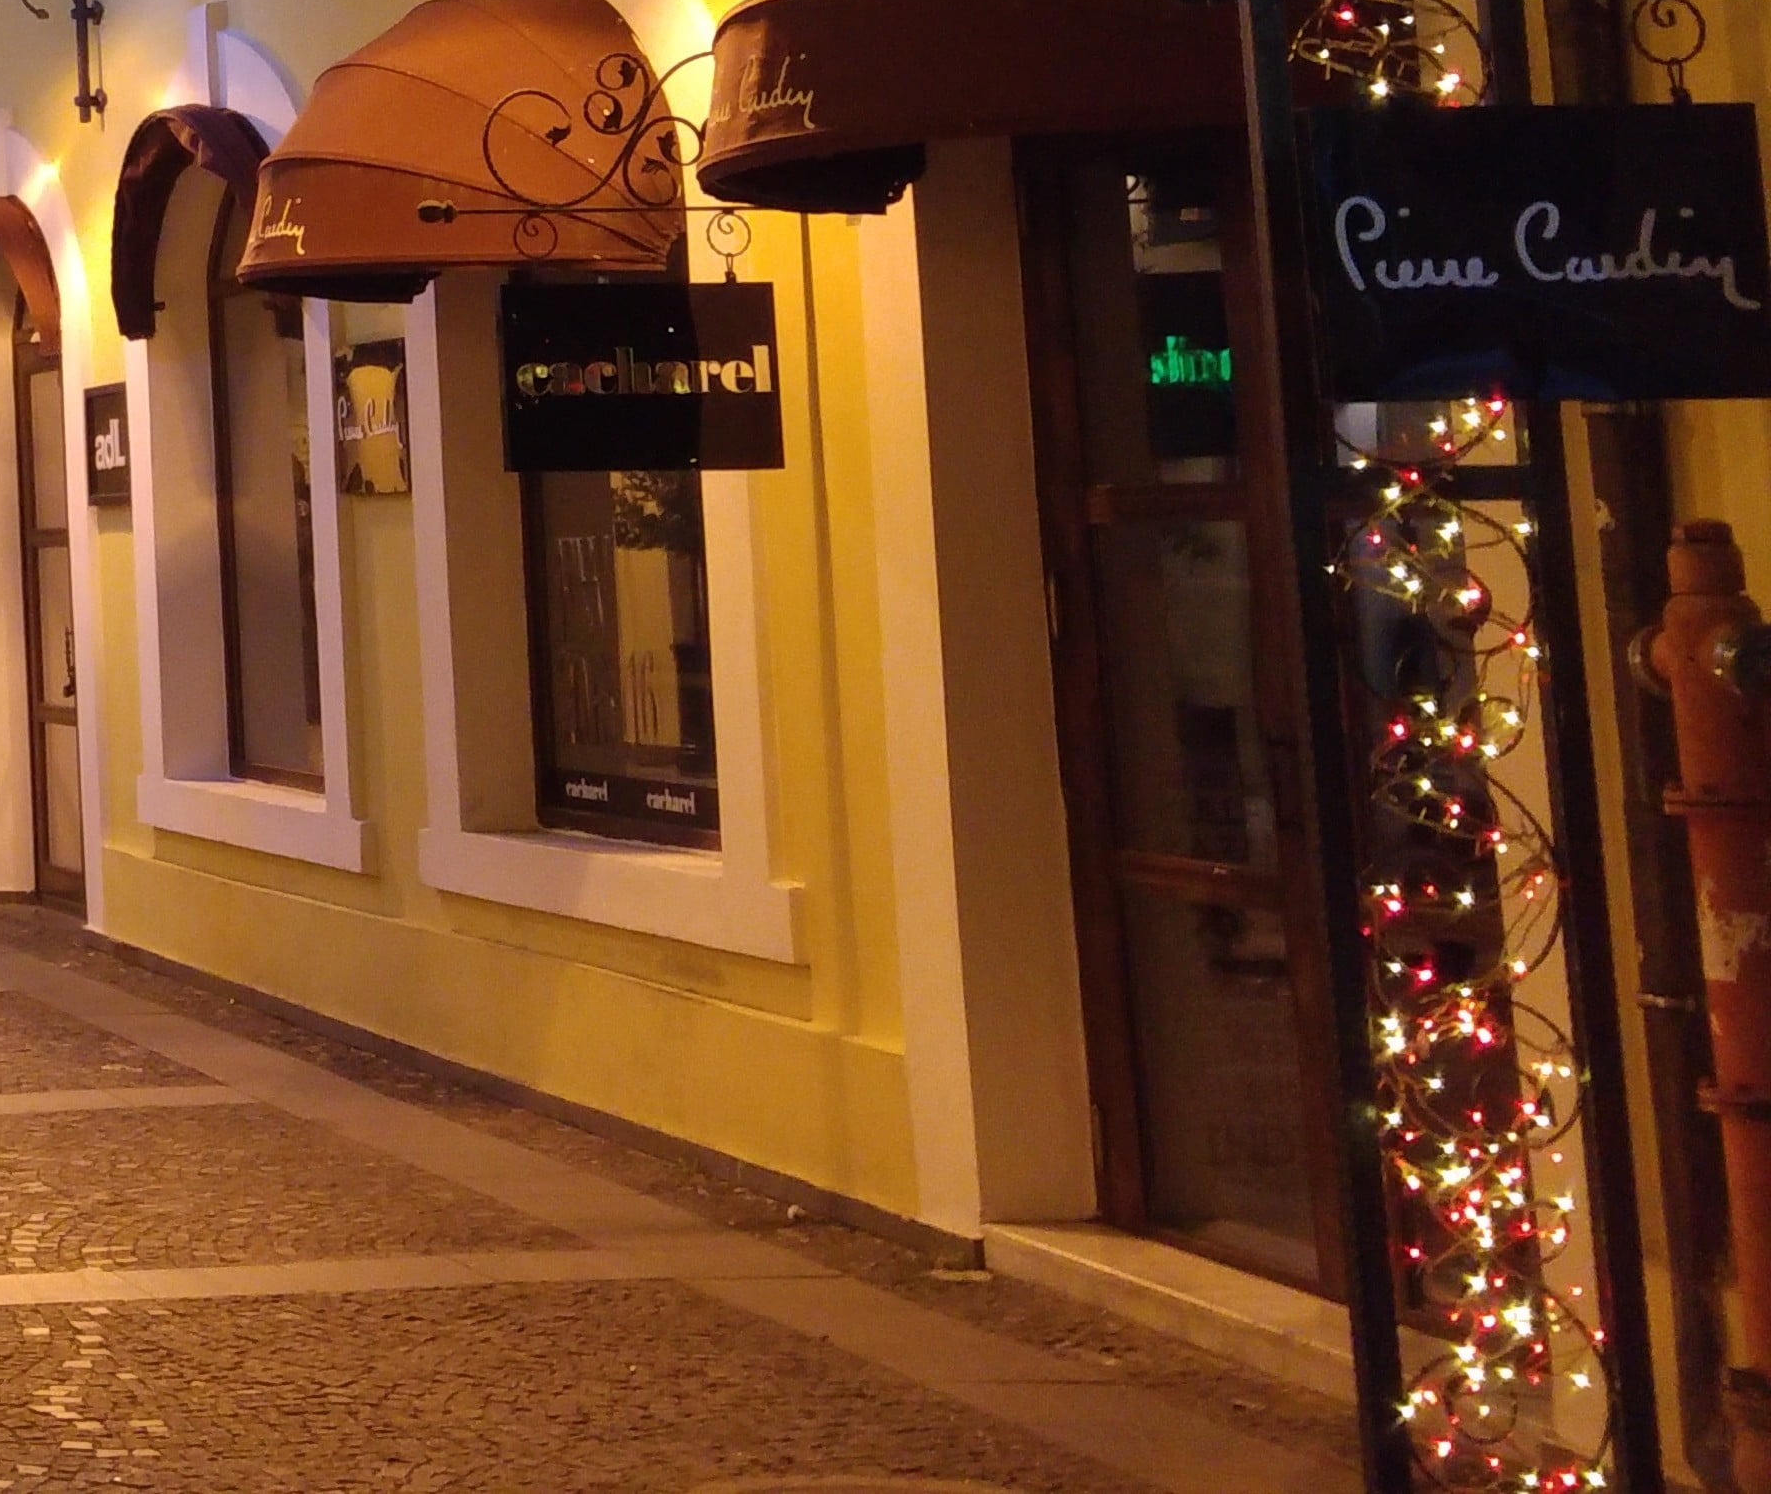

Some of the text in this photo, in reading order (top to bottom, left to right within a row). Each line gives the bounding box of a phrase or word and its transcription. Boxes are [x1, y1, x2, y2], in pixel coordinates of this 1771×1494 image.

[1335, 195, 1761, 309] Pierre Cardin
[516, 344, 773, 396] cacharel
[565, 777, 609, 802] cacharel
[646, 788, 697, 815] cacharel
